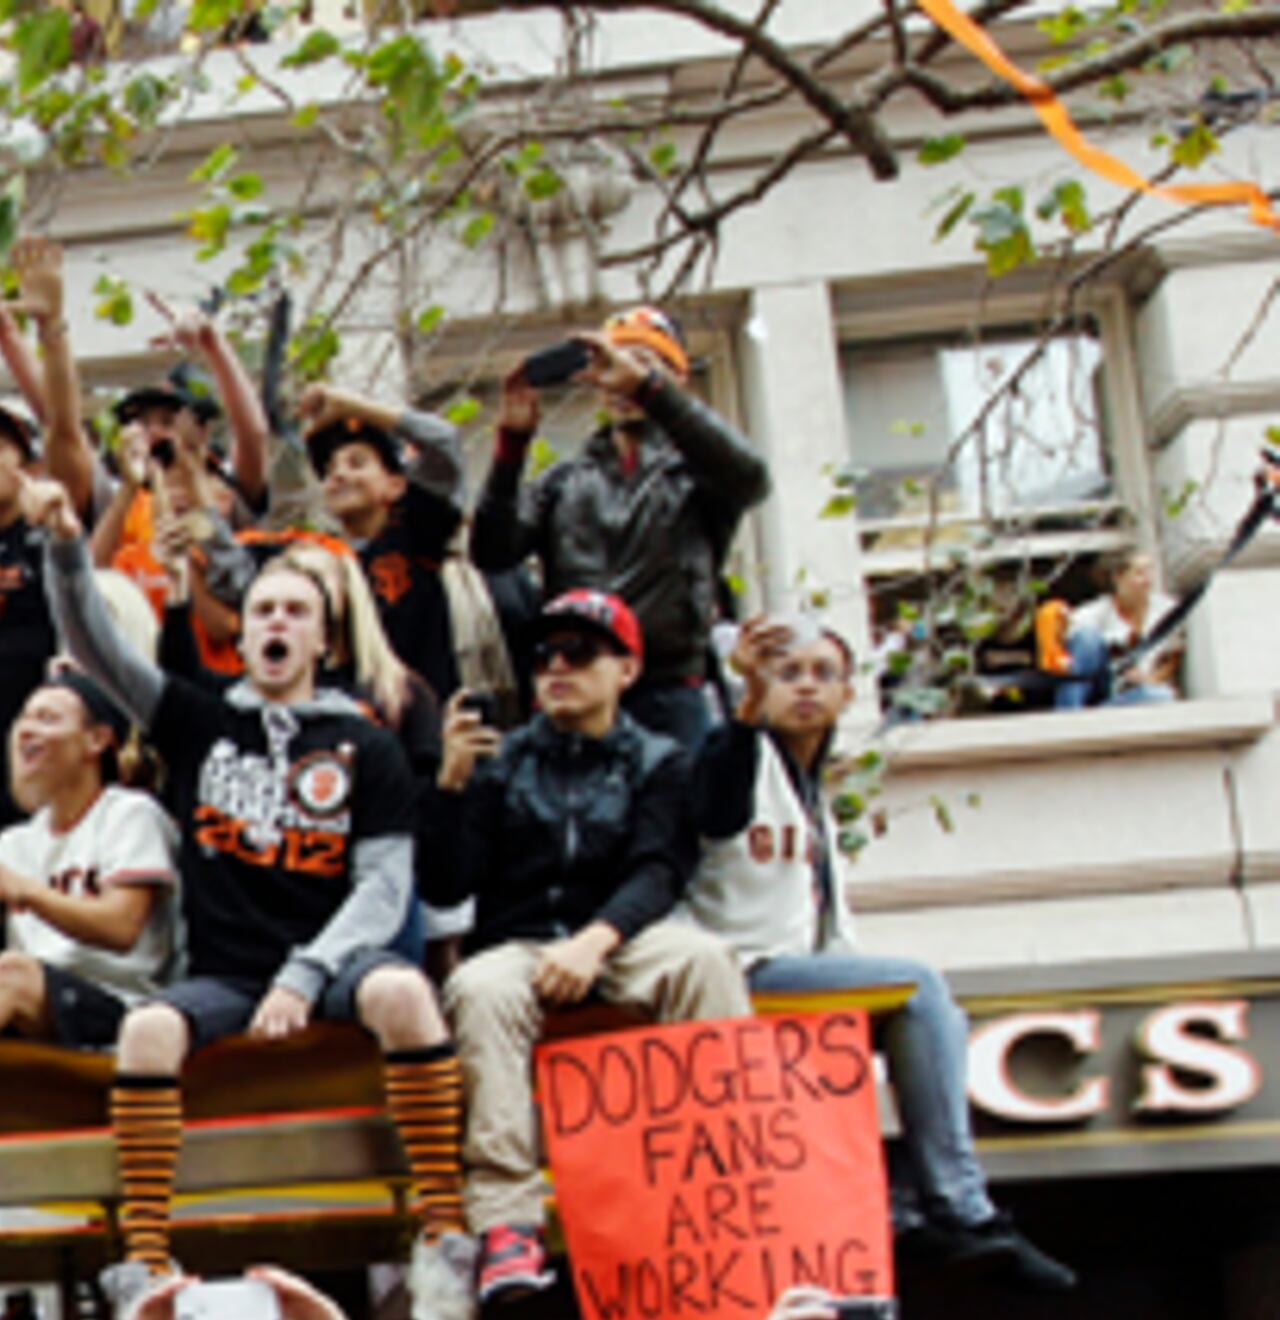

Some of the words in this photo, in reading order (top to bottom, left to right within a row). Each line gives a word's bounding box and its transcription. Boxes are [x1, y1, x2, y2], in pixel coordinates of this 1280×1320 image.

[193, 804, 346, 878] 2012
[545, 1013, 870, 1137] DODGERS
[968, 1002, 1262, 1122] CS
[643, 1108, 807, 1186] FANS
[666, 1179, 781, 1248] ARE
